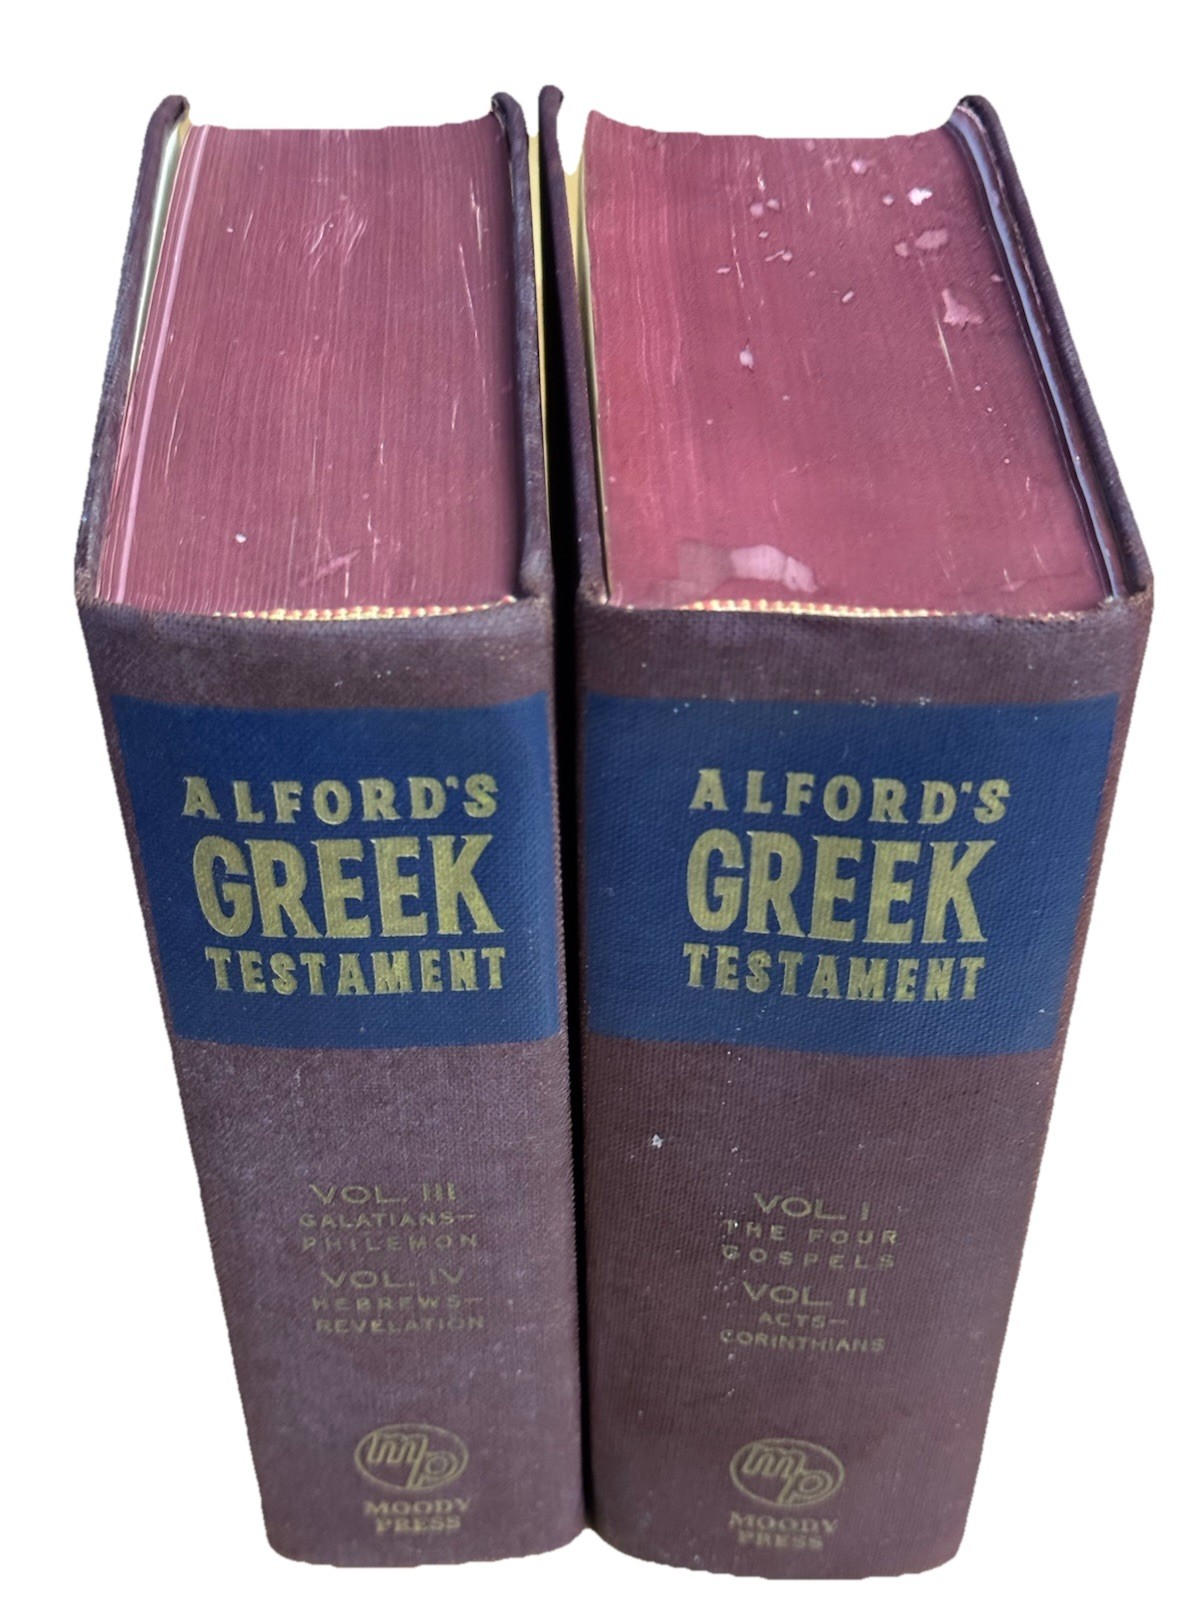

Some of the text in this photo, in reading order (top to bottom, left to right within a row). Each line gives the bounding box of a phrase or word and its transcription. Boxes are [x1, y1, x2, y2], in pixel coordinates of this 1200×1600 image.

[181, 773, 498, 825] ALFORD'S
[688, 769, 1012, 824] ALFORD'S
[192, 834, 504, 938] GREEK
[686, 828, 997, 944] GREEK
[205, 947, 506, 996] TESTAMENT
[683, 943, 986, 1002] TESTAMENT
[422, 1182, 457, 1202] III
[859, 1201, 871, 1221] I
[302, 1233, 478, 1251] PHILEMON
[724, 1218, 898, 1245] THE FOUR
[722, 1244, 895, 1270] GOSPELS
[430, 1267, 465, 1285] IV
[847, 1287, 868, 1308] II
[315, 1315, 485, 1335] REVELATION
[720, 1328, 886, 1353] CORINTHIANS
[363, 1497, 471, 1515] MOODY
[728, 1511, 838, 1535] MOODY
